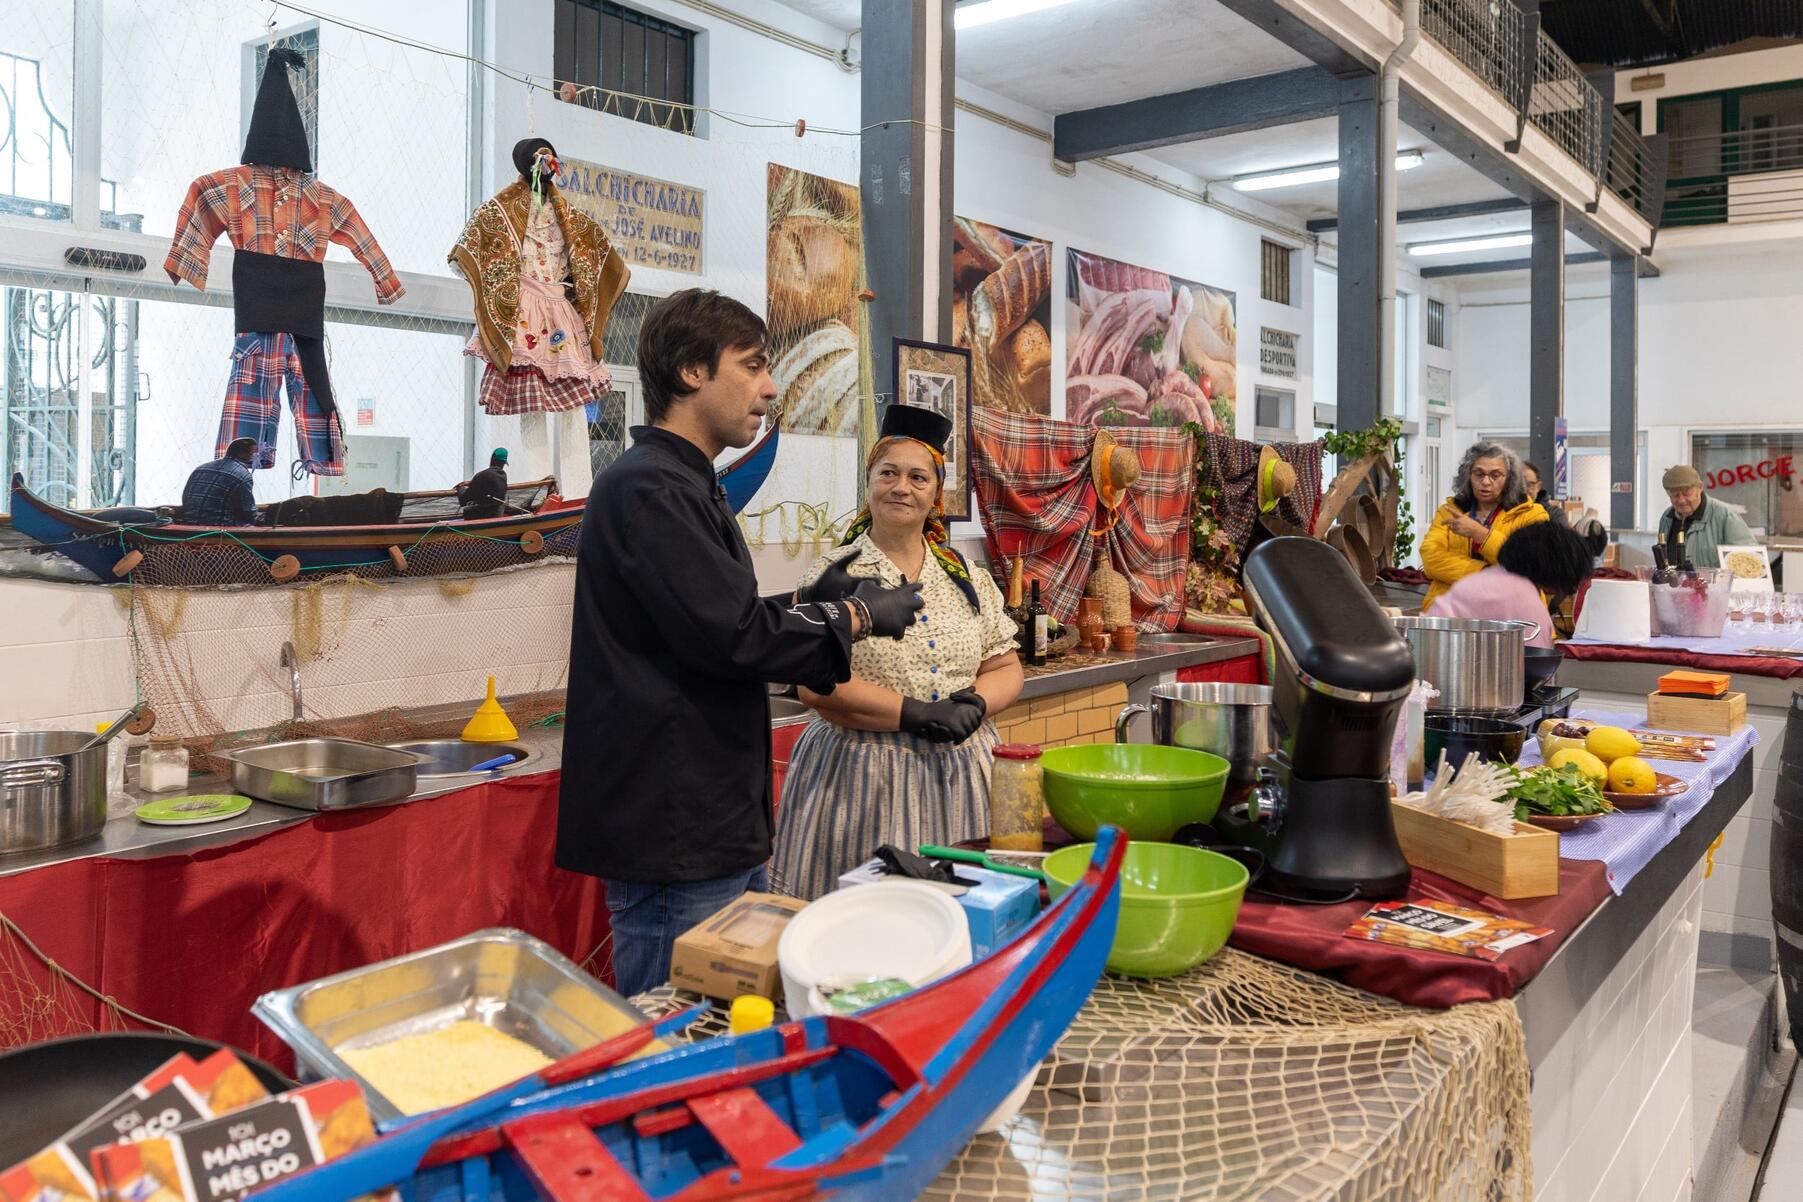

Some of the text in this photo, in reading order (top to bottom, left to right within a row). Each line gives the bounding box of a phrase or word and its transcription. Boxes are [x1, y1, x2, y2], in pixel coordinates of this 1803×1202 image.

[202, 1128, 292, 1170] MARÇO
[208, 1165, 260, 1196] MÊS
[259, 1152, 300, 1180] DO
